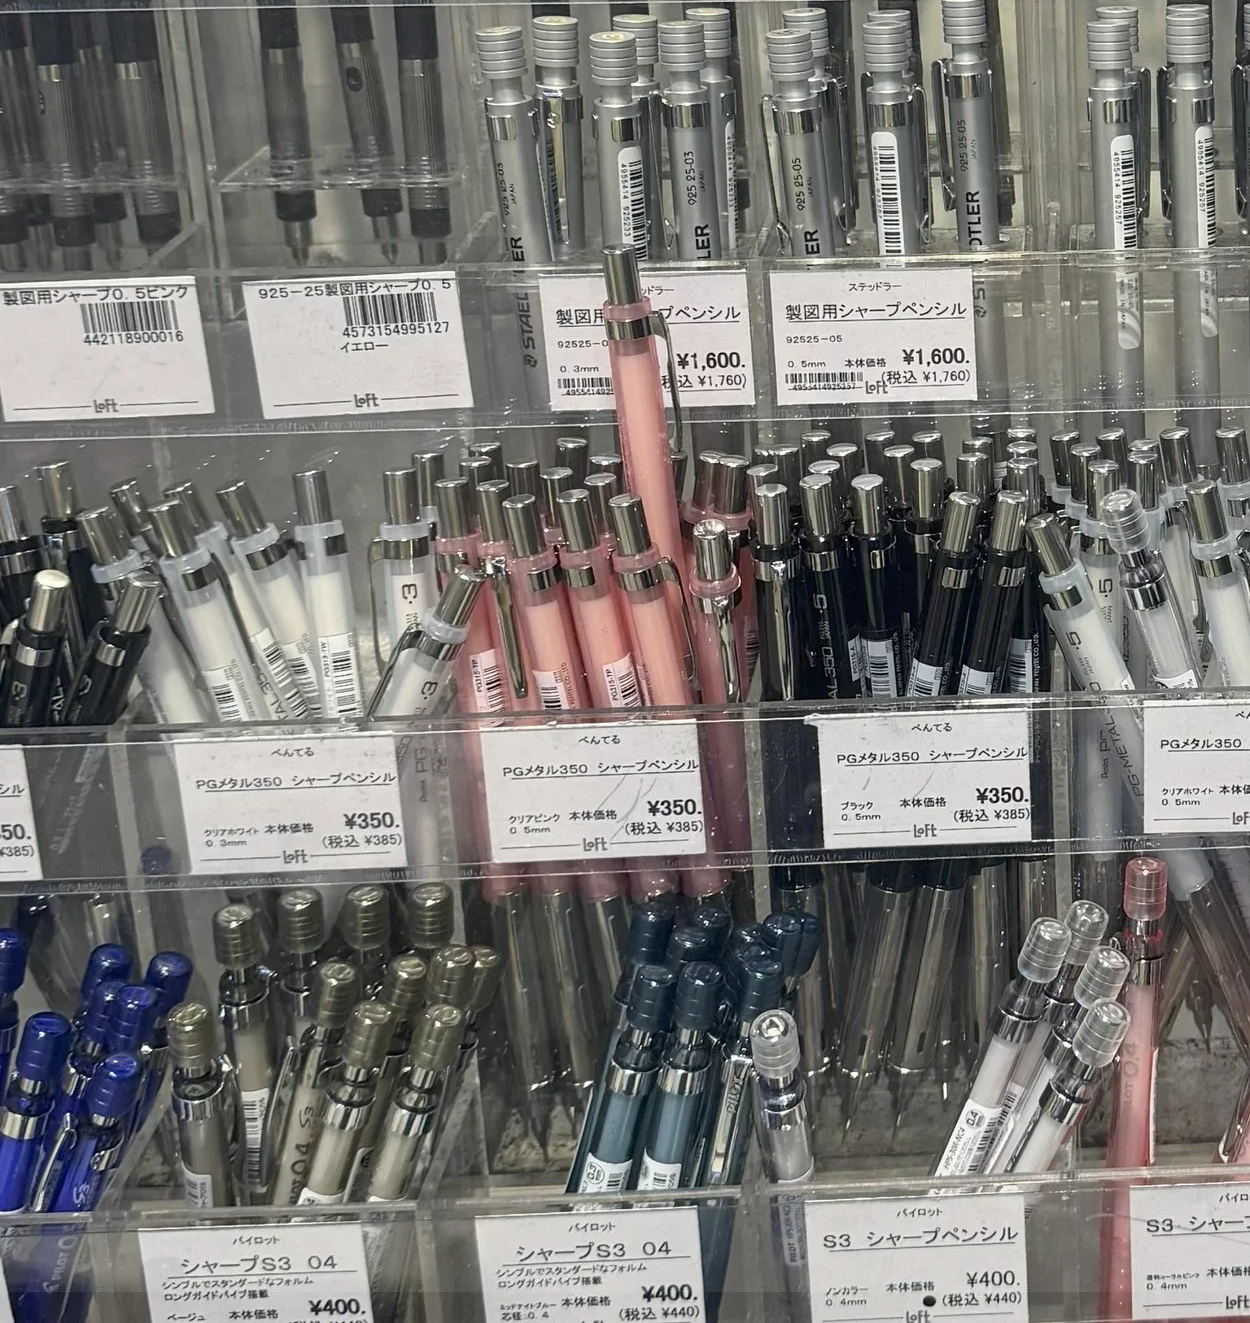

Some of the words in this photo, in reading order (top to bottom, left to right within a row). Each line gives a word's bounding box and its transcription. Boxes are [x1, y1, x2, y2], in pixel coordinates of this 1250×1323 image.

[849, 282, 901, 292] ステッドラー
[785, 301, 967, 320] 製図用シャープペンシル
[342, 317, 449, 338] 4573154995127
[84, 330, 184, 345] 442118900016
[340, 341, 389, 353] イエロー
[922, 369, 970, 383] ¥1,760)
[1160, 738, 1242, 749] PGメタル350
[837, 752, 919, 764] PGメタル350
[929, 747, 1028, 761] シャープペンシル
[503, 764, 588, 777] PGメタル350
[599, 757, 701, 775] シャープペンシル
[196, 777, 282, 789] PGメタル350
[292, 772, 396, 786] シャープペンシル
[364, 833, 402, 846] ¥385)
[1146, 1218, 1173, 1233] S3
[823, 1234, 851, 1248] S3
[867, 1227, 1018, 1247] シャープペンシル
[517, 1241, 626, 1262] シャープS3
[181, 1255, 291, 1275] シャープS3
[825, 1286, 868, 1296] ノンカラー
[984, 1291, 1021, 1305] ¥440)
